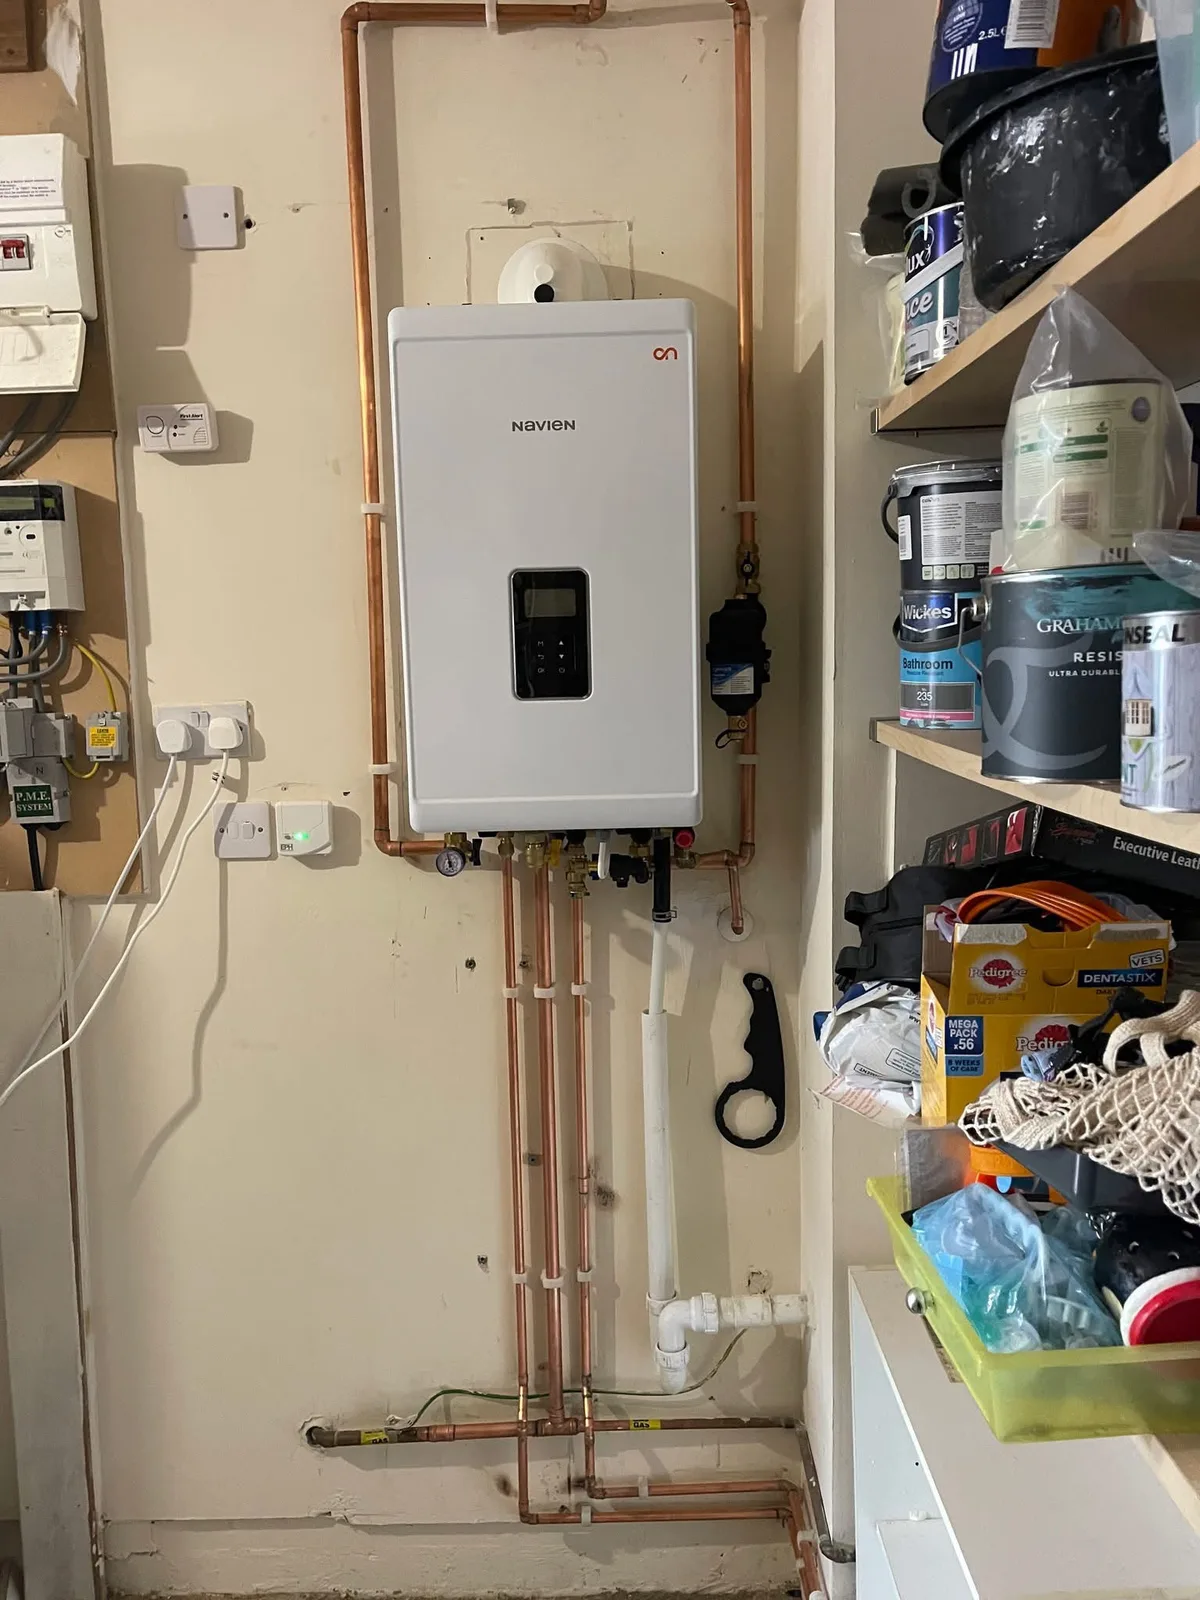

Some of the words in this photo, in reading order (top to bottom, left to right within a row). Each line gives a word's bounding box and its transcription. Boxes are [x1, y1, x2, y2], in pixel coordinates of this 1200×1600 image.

[978, 28, 1000, 40] 2.5L
[904, 604, 952, 620] Wickes
[1036, 617, 1121, 634] GRAHAM
[1073, 651, 1122, 662] RESIS
[903, 657, 953, 670] Bathroom
[916, 691, 932, 701] 235
[16, 791, 51, 802] P.M.E.
[16, 803, 52, 812] SYSTEM
[1113, 836, 1169, 862] Executive
[1131, 955, 1162, 966] VETS
[969, 967, 1026, 978] Pedigree
[1084, 972, 1156, 983] DENTASTIX
[949, 1019, 979, 1028] MEGA
[950, 1029, 978, 1038] PACK
[953, 1038, 975, 1050] x56
